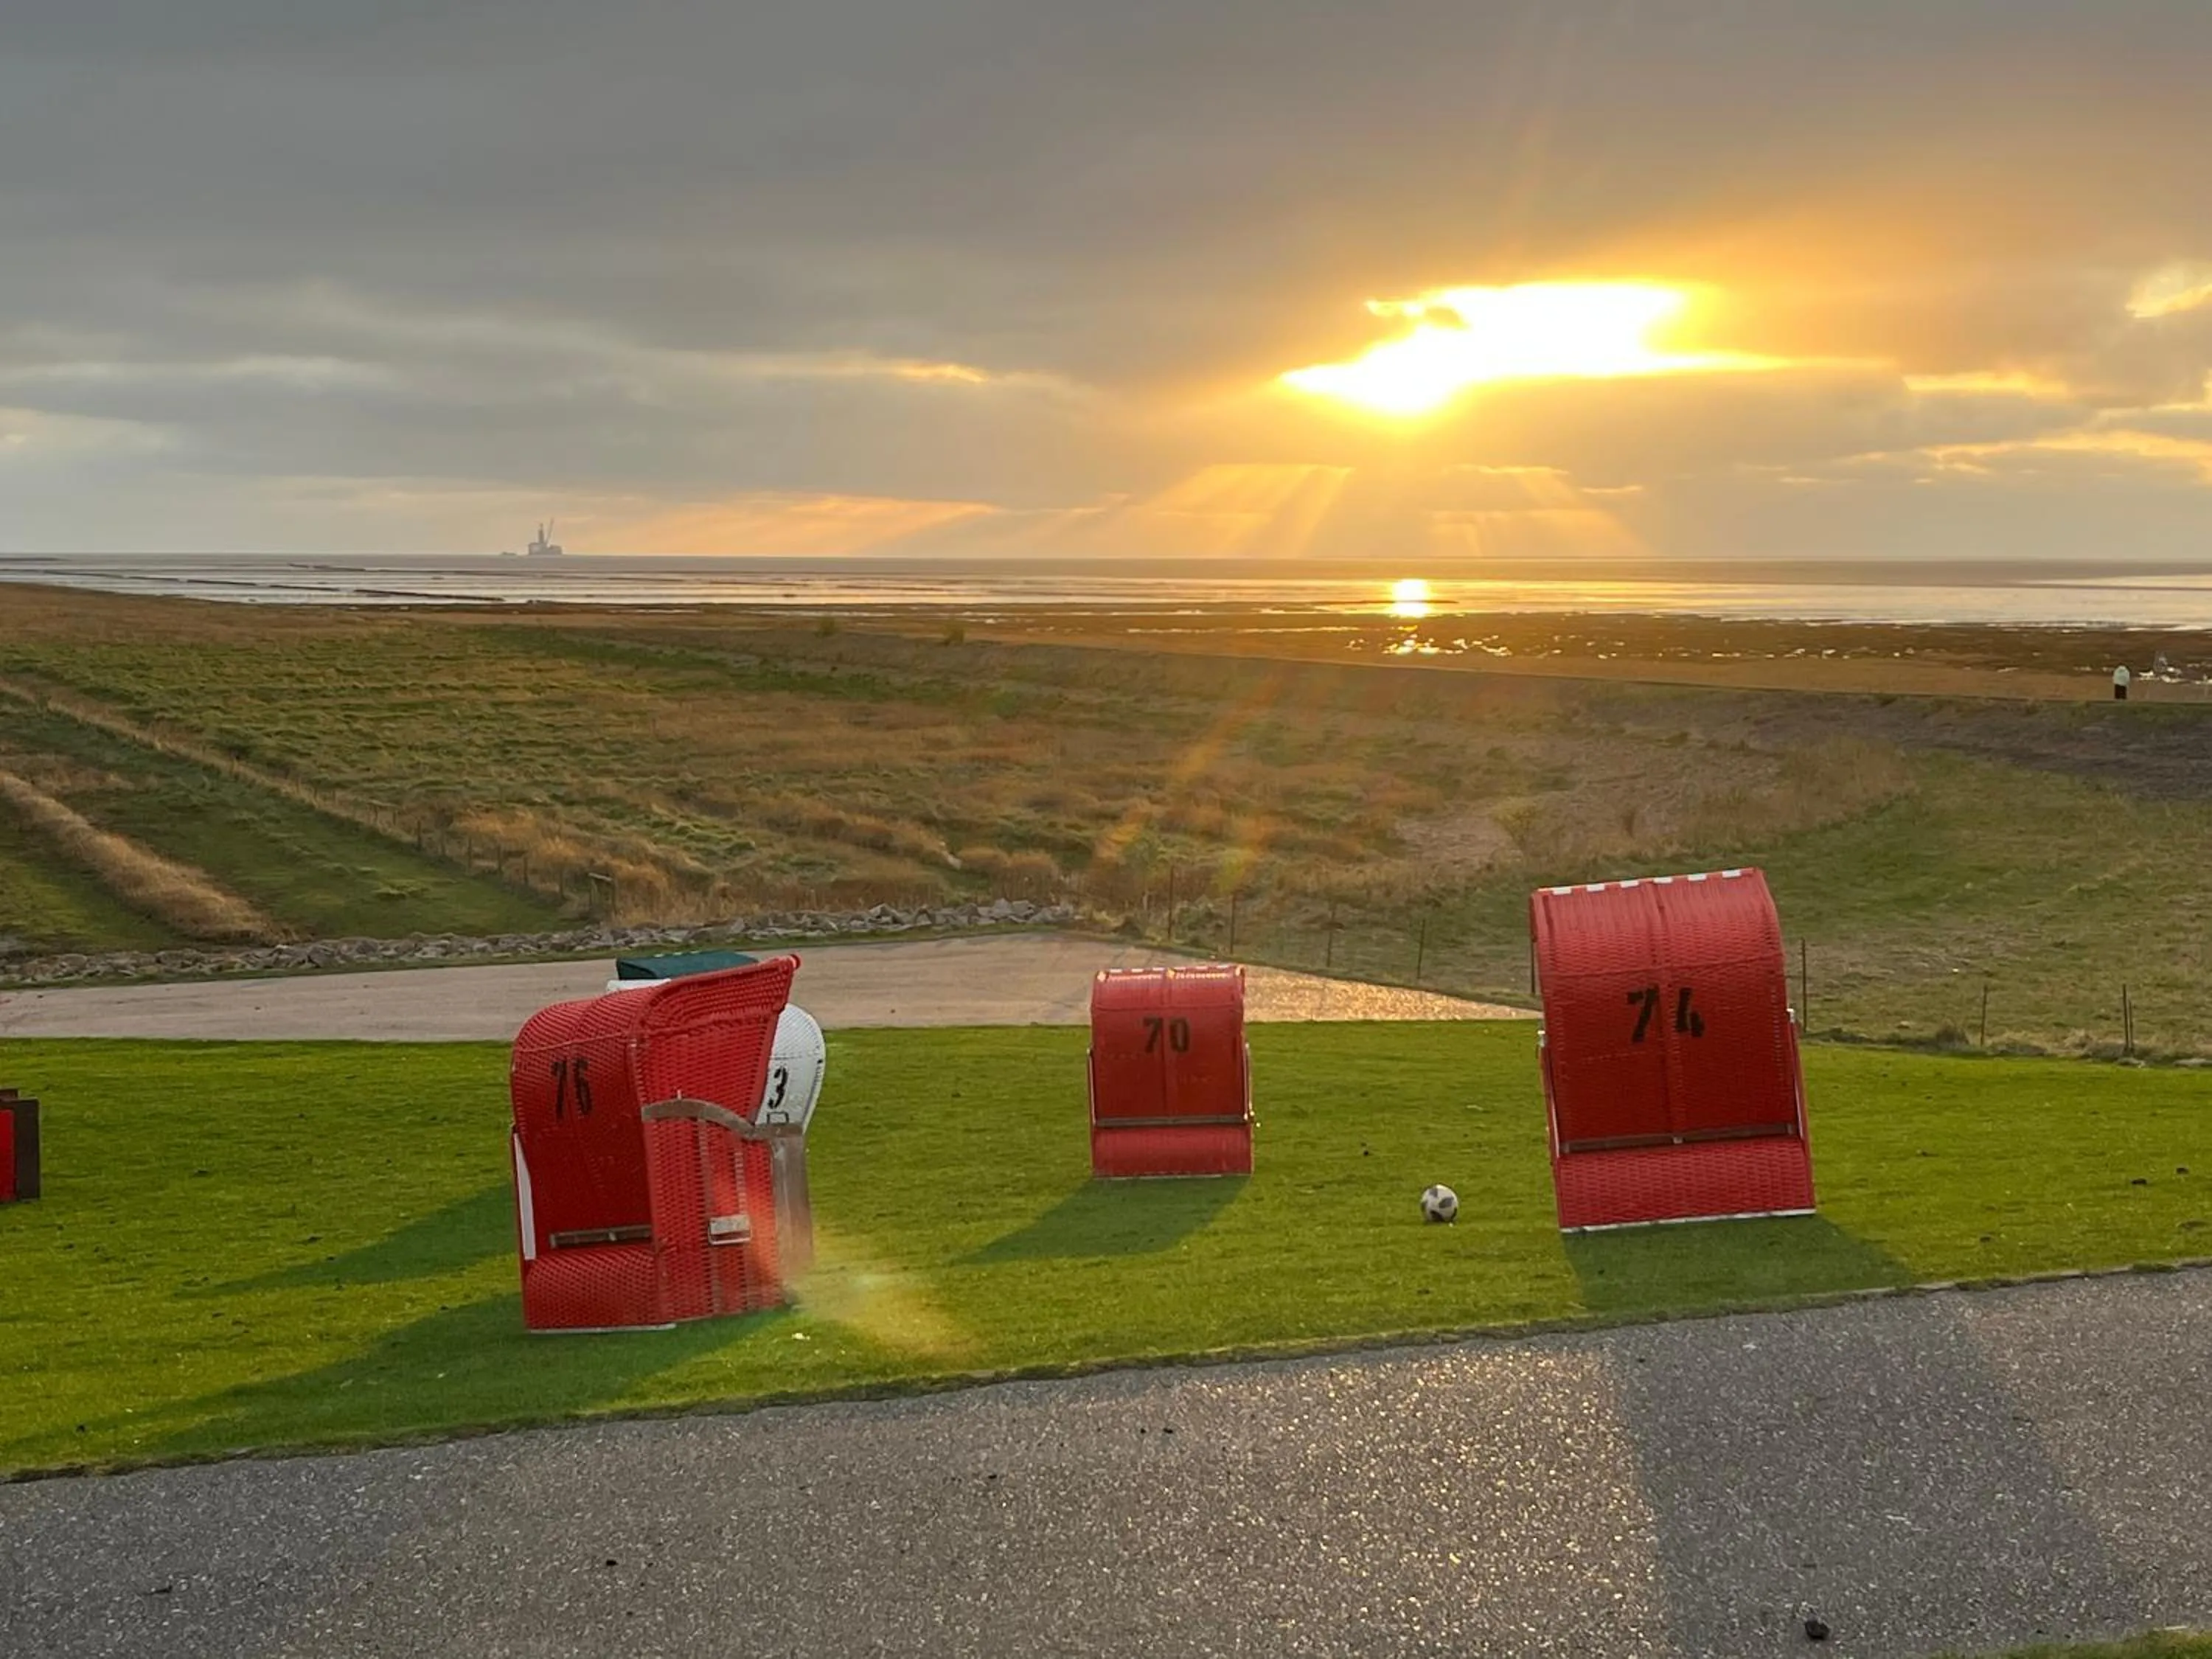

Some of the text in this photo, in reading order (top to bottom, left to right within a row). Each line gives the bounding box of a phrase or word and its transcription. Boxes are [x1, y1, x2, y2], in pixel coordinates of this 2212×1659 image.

[1141, 1016, 1190, 1054] 70
[1627, 983, 1705, 1043] 74
[550, 1057, 594, 1120] 76
[768, 1066, 787, 1109] 3
